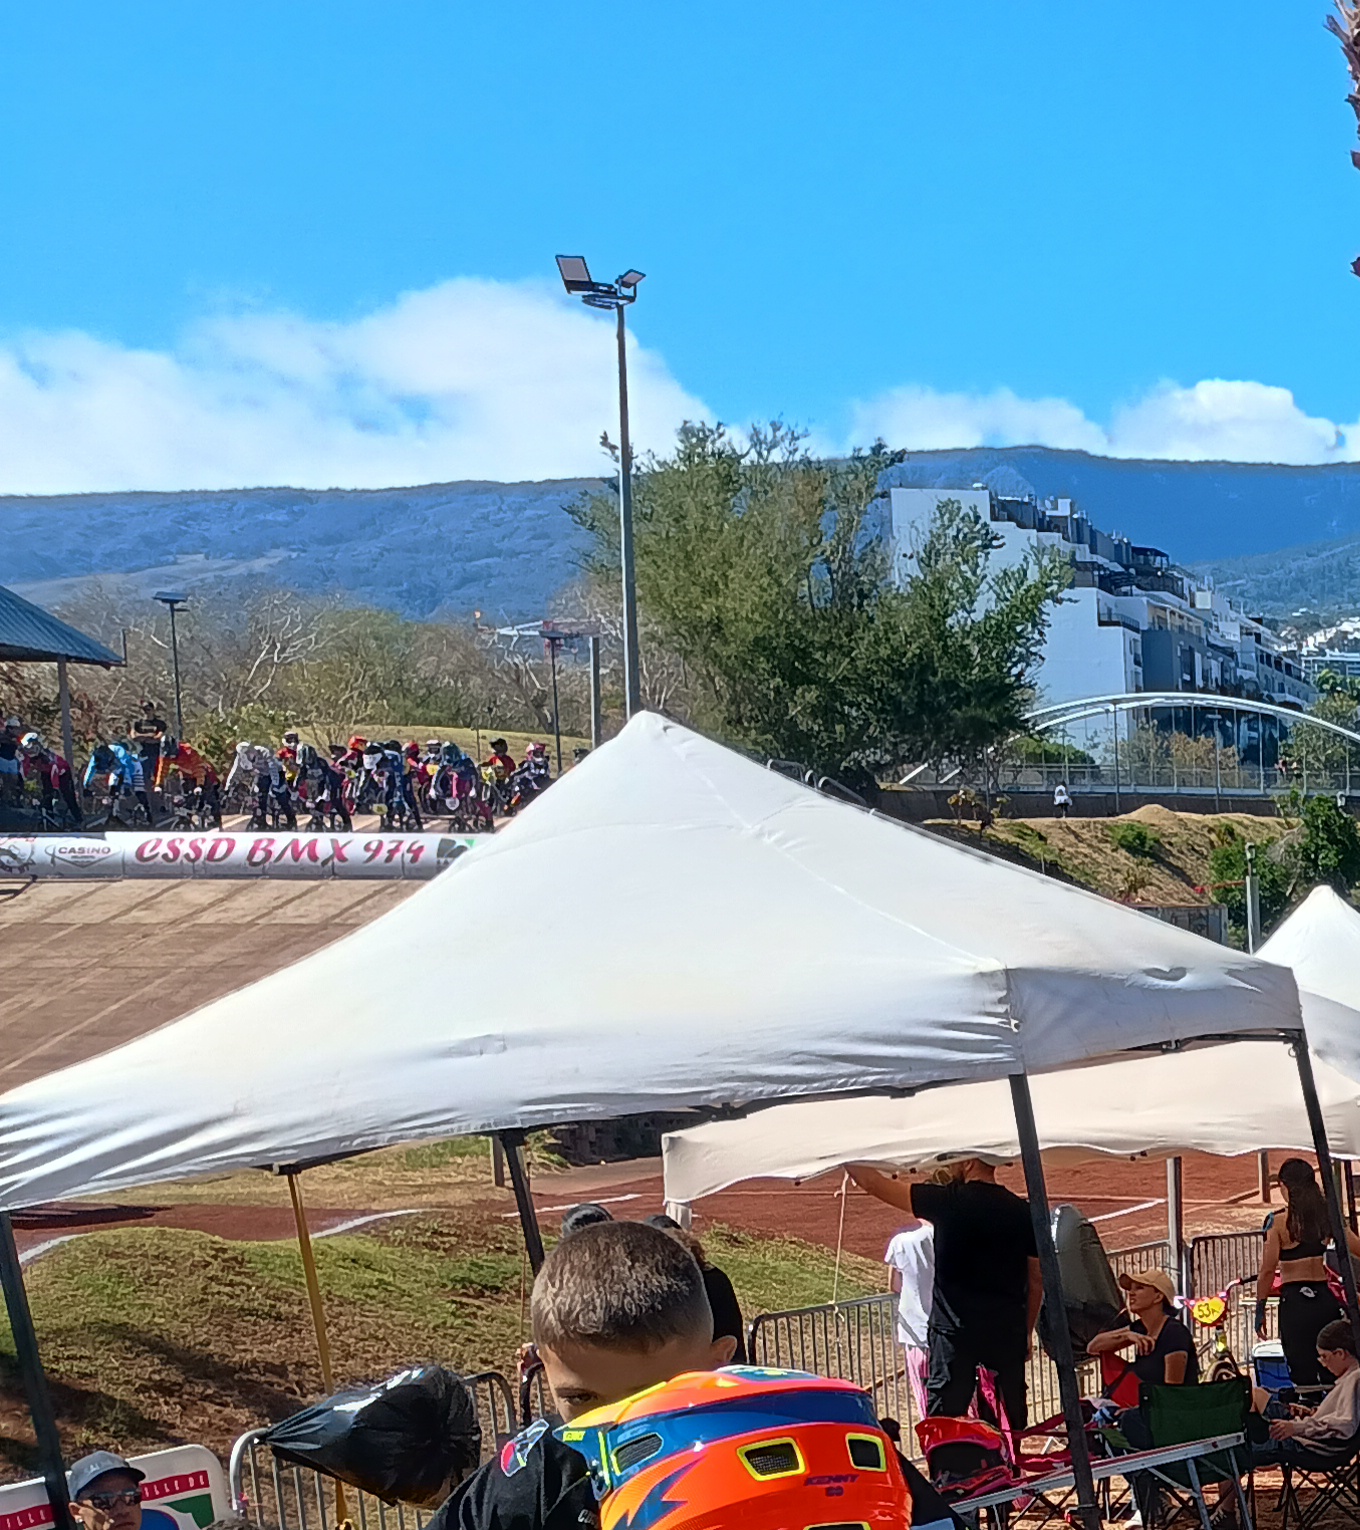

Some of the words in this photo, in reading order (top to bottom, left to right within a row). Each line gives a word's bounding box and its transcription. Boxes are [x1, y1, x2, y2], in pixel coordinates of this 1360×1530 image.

[58, 846, 111, 855] CASINO
[135, 837, 236, 863] CSSD
[246, 837, 352, 868] BMX
[363, 839, 425, 864] 974
